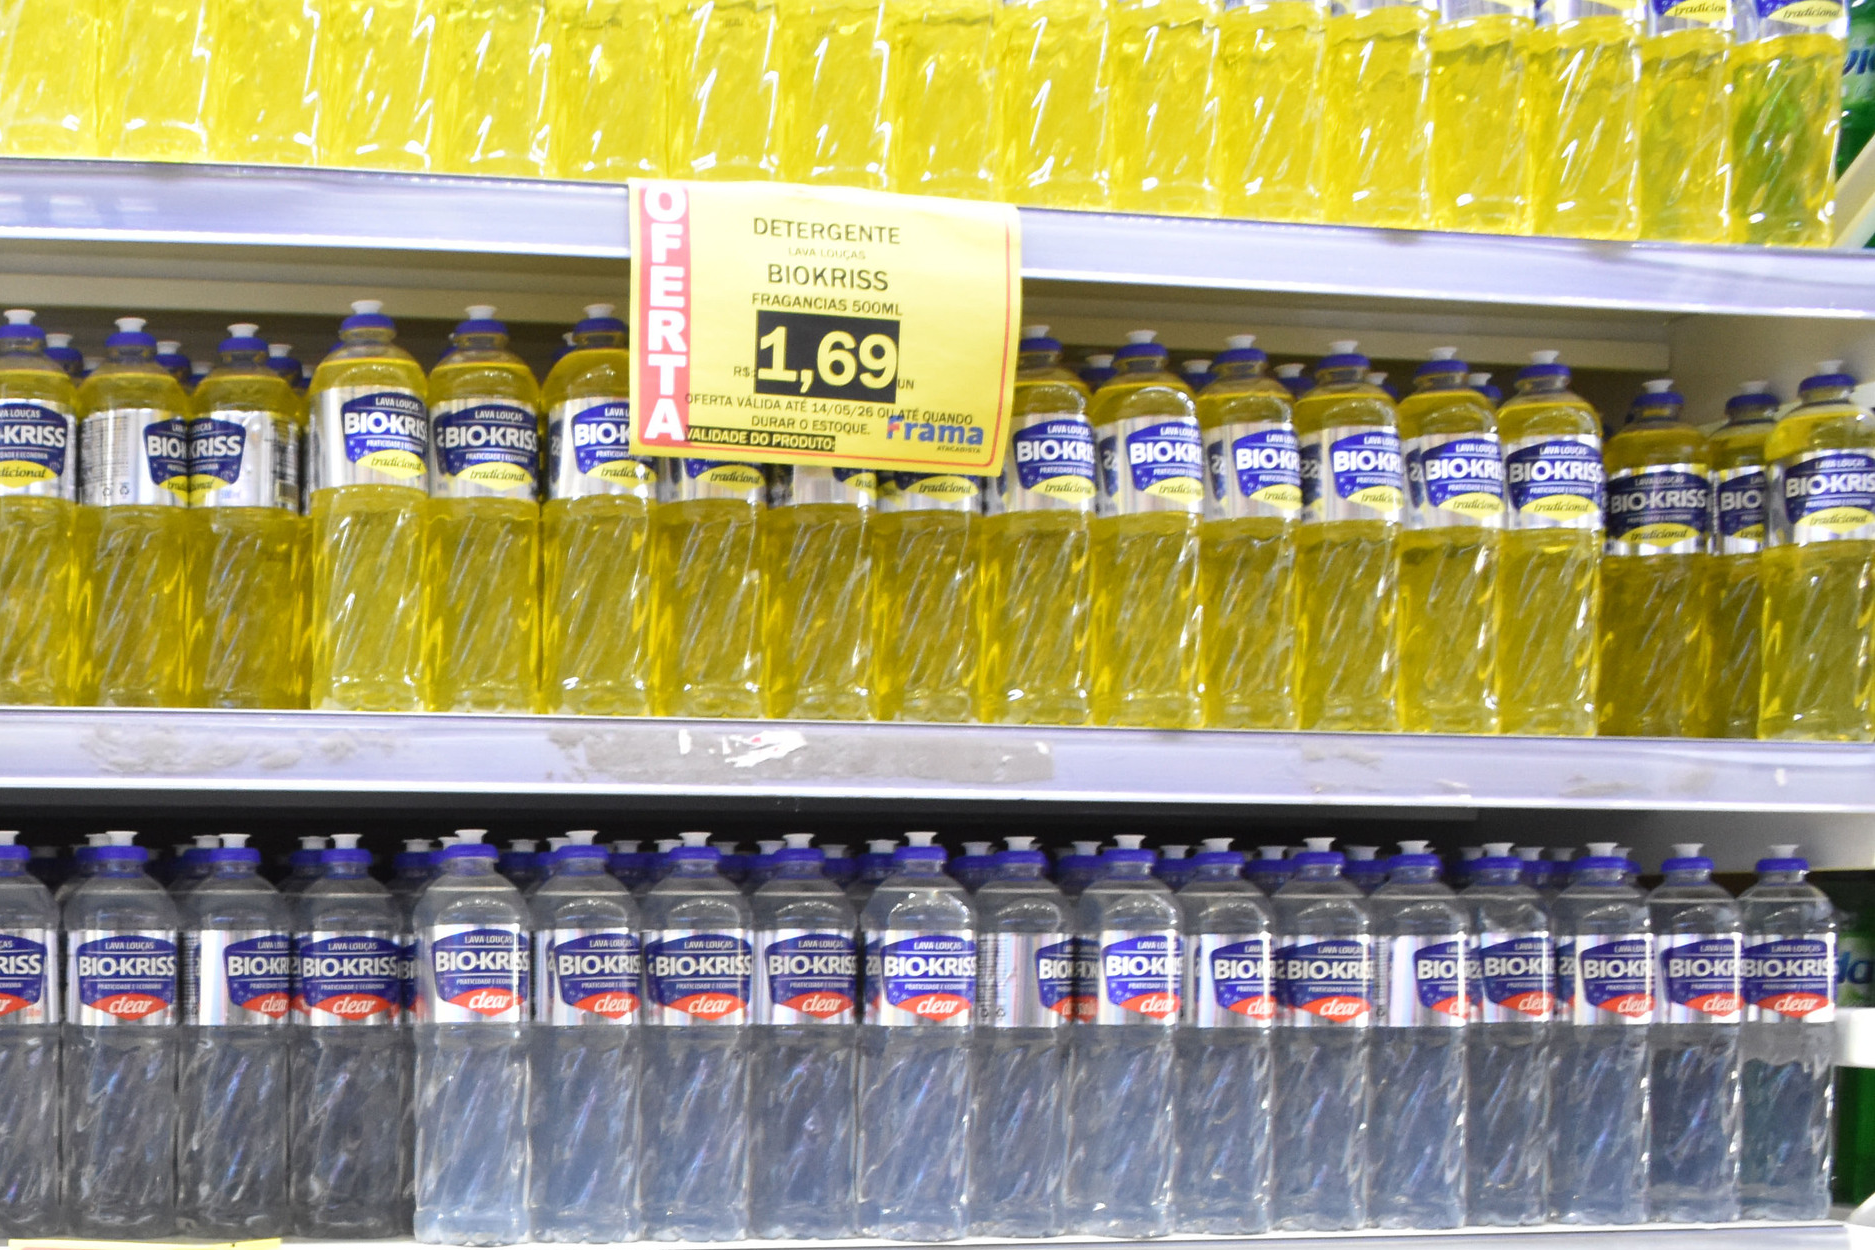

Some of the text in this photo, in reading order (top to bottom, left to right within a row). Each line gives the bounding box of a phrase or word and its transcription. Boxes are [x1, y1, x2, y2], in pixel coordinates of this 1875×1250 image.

[1783, 6, 1839, 18] tradicional
[753, 218, 900, 244] DETERGENTE
[788, 247, 816, 257] LAVA
[768, 264, 889, 291] BIOKRISS
[644, 185, 687, 440] OFERTA
[751, 293, 903, 316] FRAGANCIAS 500ML
[758, 326, 897, 393] 1,69
[897, 379, 915, 390] UN
[10, 409, 41, 420] LOUÇAS
[685, 393, 972, 426] OFERTA VÁLIDA ATÉ 14/05/26 OU ATÉ QUANDO
[751, 415, 870, 436] DURAR O ESTOQUE.
[686, 425, 835, 451] VALIDADE DO PRODUTO:
[370, 456, 422, 471] tradicional
[470, 468, 525, 482] tradicional
[918, 481, 972, 495] tradicional
[1631, 529, 1687, 541] tradicional
[108, 997, 153, 1016] clear
[333, 998, 376, 1015] clear
[689, 996, 731, 1015] clear
[917, 996, 959, 1015] clear
[1774, 996, 1817, 1013] clear
